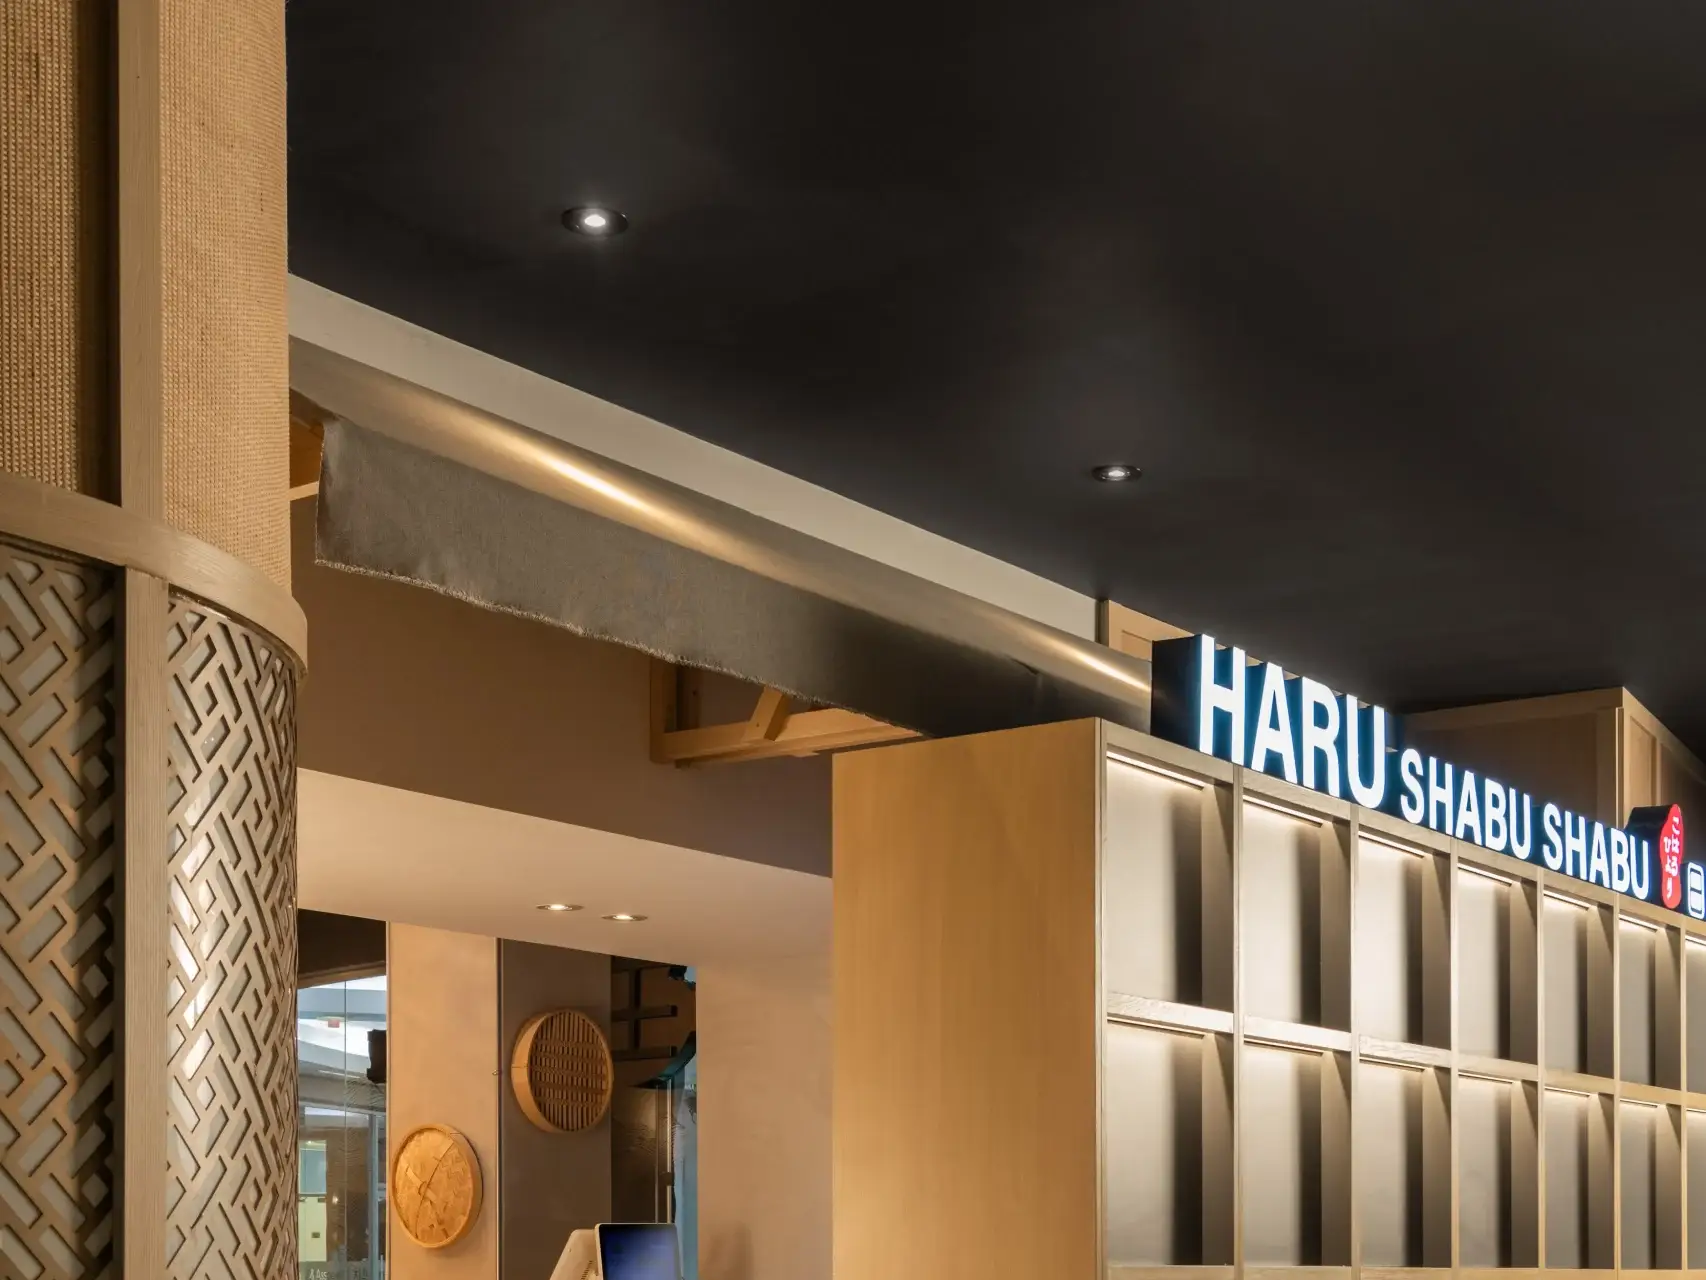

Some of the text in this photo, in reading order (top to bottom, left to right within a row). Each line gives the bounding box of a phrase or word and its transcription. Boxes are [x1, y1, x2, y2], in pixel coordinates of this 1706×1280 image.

[1200, 634, 1649, 900] HARU SHABU SHABU
